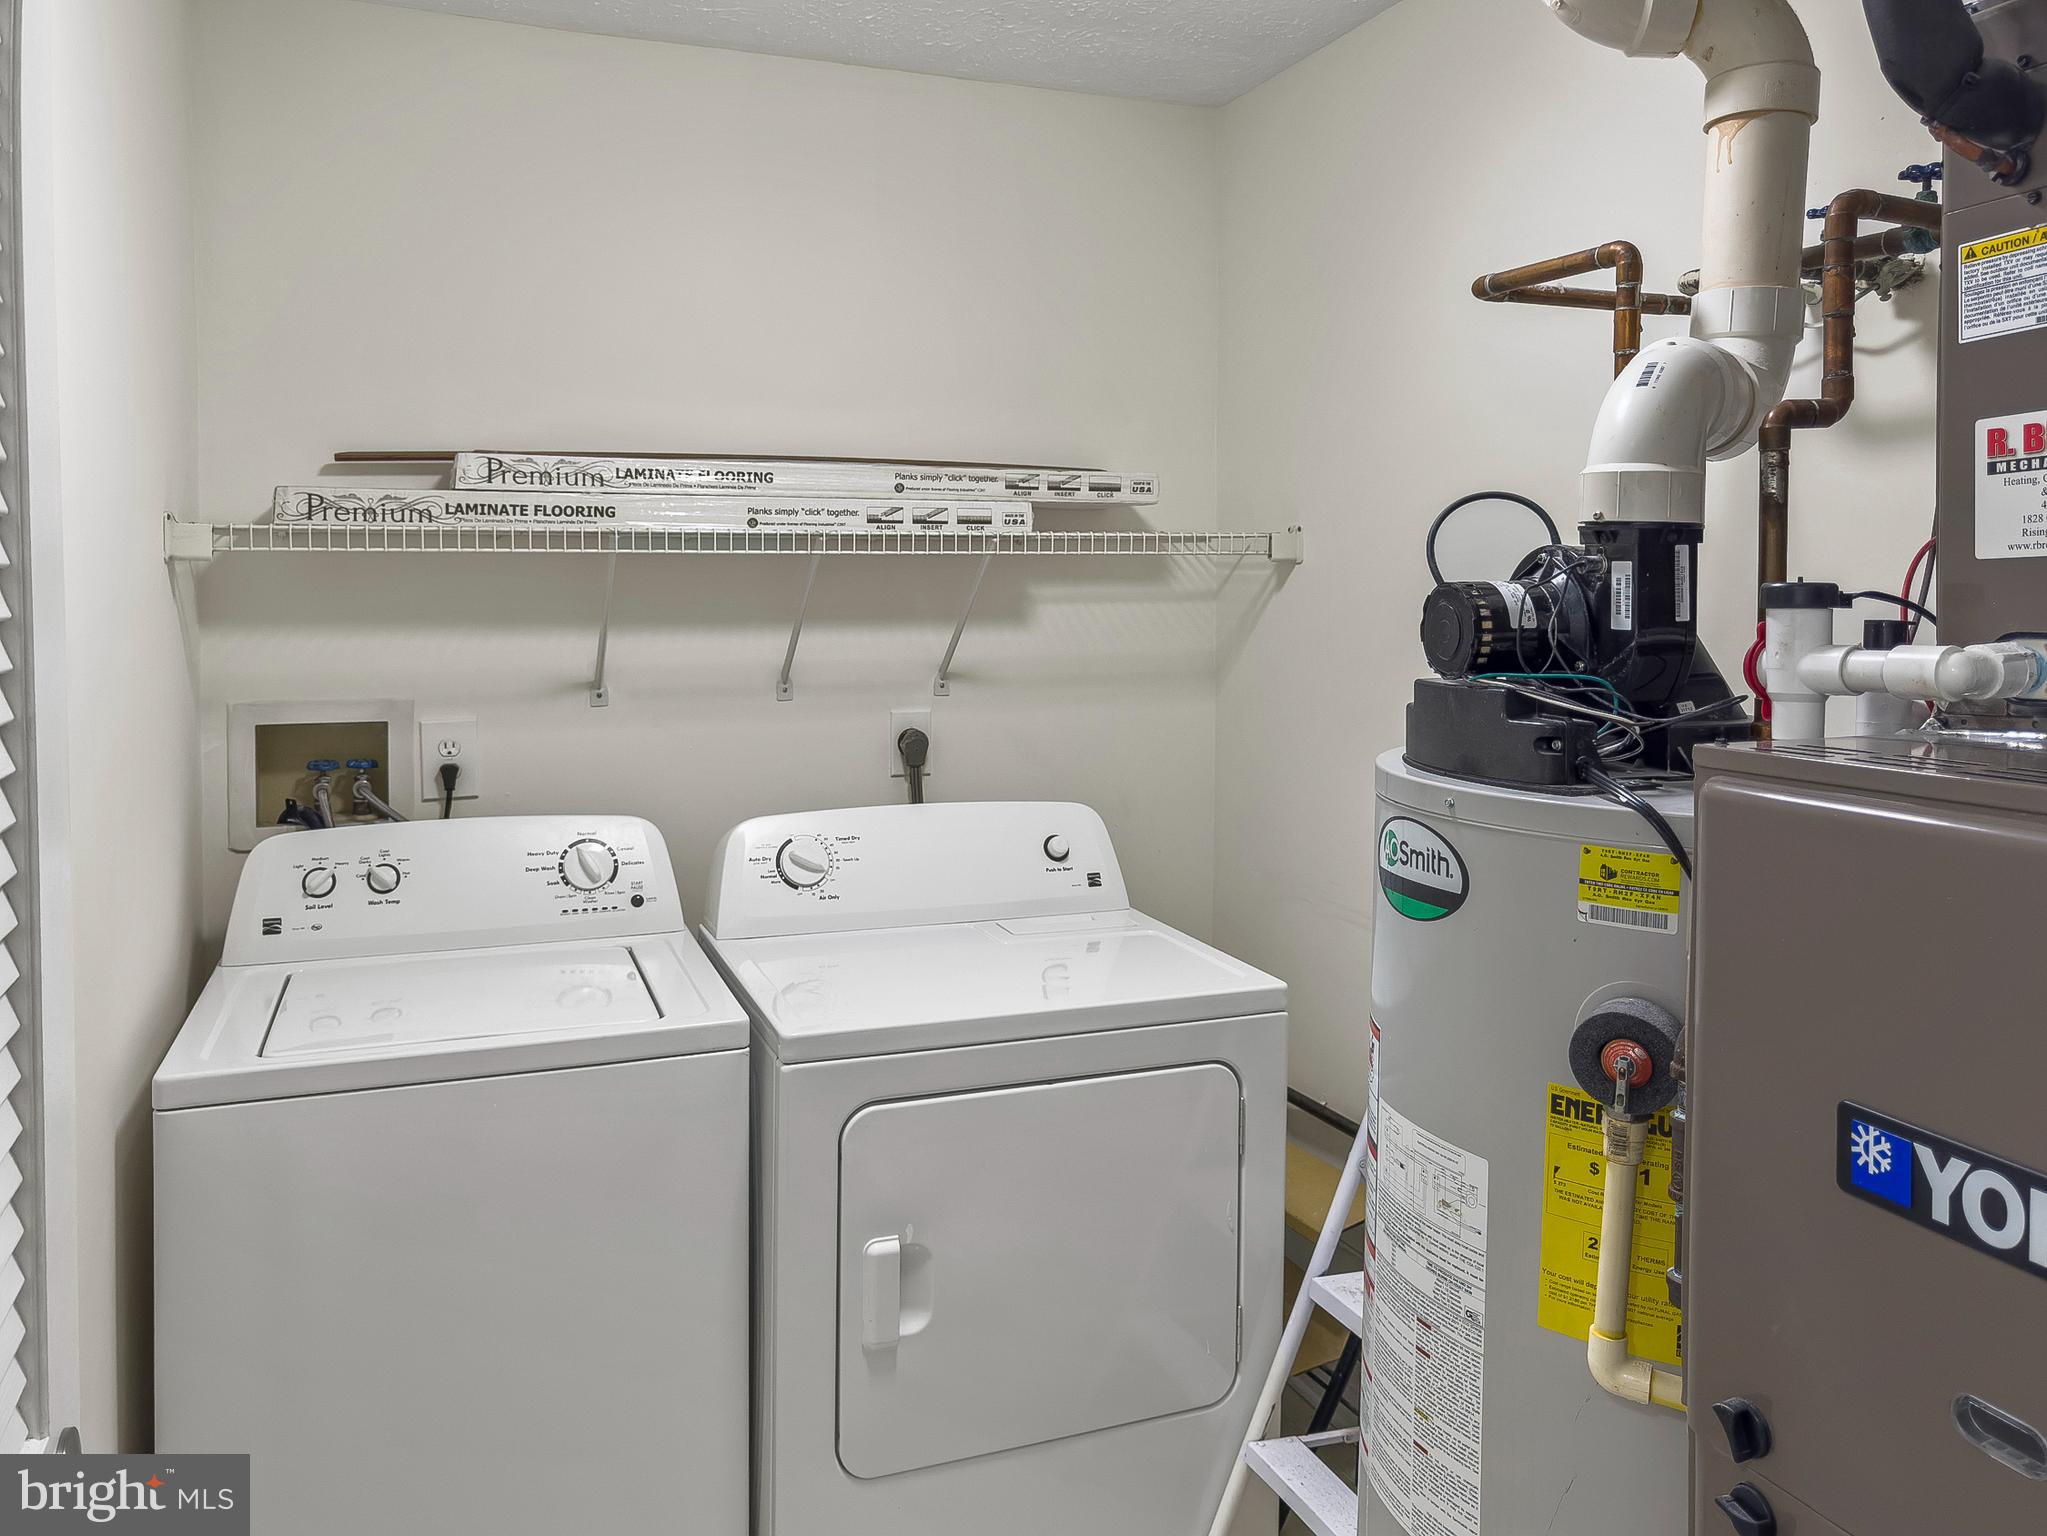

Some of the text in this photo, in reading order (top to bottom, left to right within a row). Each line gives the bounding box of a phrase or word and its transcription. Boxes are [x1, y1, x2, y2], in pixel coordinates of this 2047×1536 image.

[1981, 236, 2030, 256] CAUTION
[1987, 423, 2047, 458] R. B
[487, 457, 606, 488] Premium
[894, 472, 999, 484] Planks simply "click" together.
[2003, 475, 2041, 487] Heating,
[307, 492, 616, 523] Premium LAMINATE FLOORING
[747, 507, 860, 517] Planks simply "click" together.
[2022, 514, 2044, 524] 1828
[1620, 868, 1660, 878] CONTRACTOR
[305, 902, 334, 911] Soil Level
[1567, 1142, 1670, 1171] Estimated erating
[1589, 1161, 1650, 1186] $ 1
[1587, 1188, 1600, 1196] Cost
[1558, 1194, 1571, 1202] WAS
[1571, 1198, 1583, 1206] NOT
[1564, 1190, 1595, 1203] ESTIMATED
[1642, 1208, 1658, 1217] COST
[1636, 1254, 1666, 1266] THERMS
[1632, 1264, 1652, 1273] Energy
[1542, 1267, 1660, 1306] Your cost will utility
